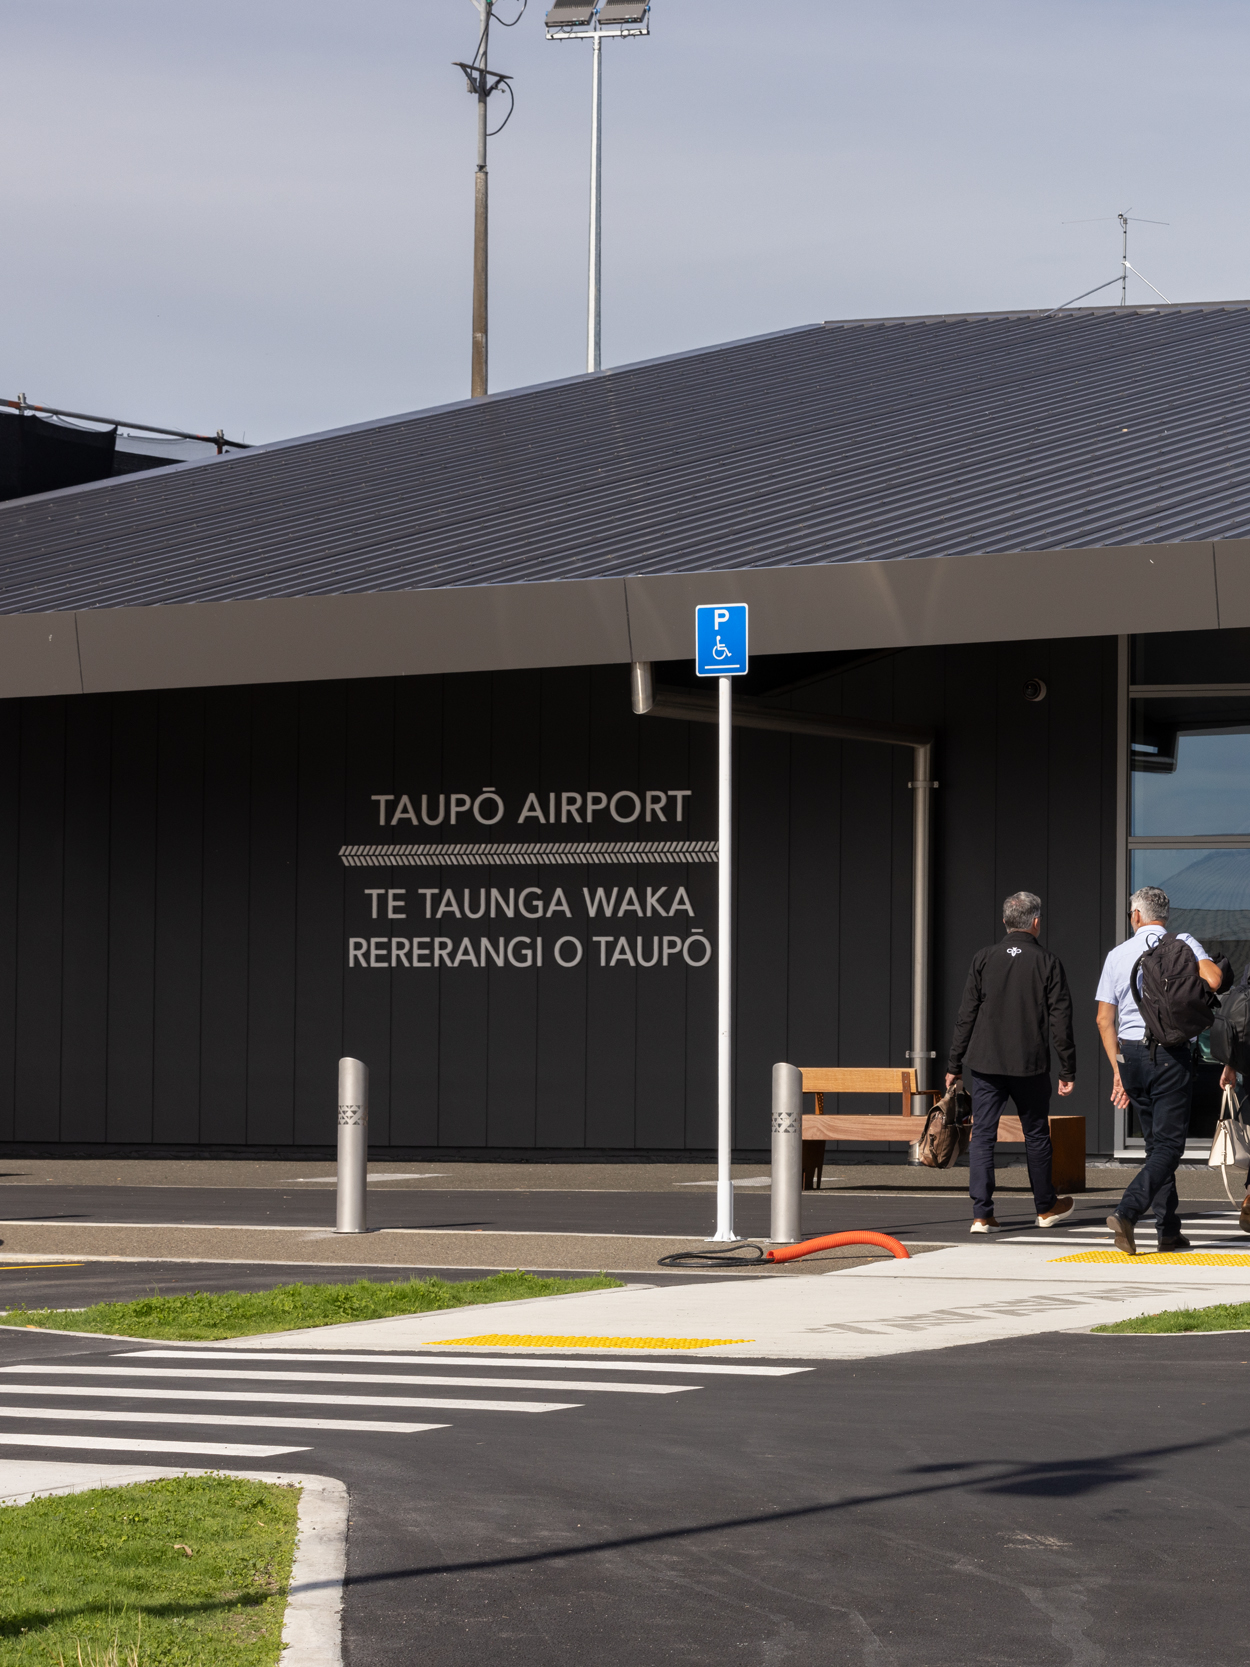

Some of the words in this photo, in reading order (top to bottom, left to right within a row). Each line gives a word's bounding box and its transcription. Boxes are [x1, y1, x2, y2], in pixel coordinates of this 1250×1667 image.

[714, 609, 730, 630] P
[371, 787, 505, 826] TAUPŌ
[517, 790, 692, 824] AIRPORT
[364, 888, 407, 919] TE
[418, 887, 572, 919] TAUNGA
[583, 886, 695, 918] WAKA
[348, 936, 543, 968] RERERANGI
[553, 935, 583, 968] O
[592, 928, 712, 967] TAUPŌ
